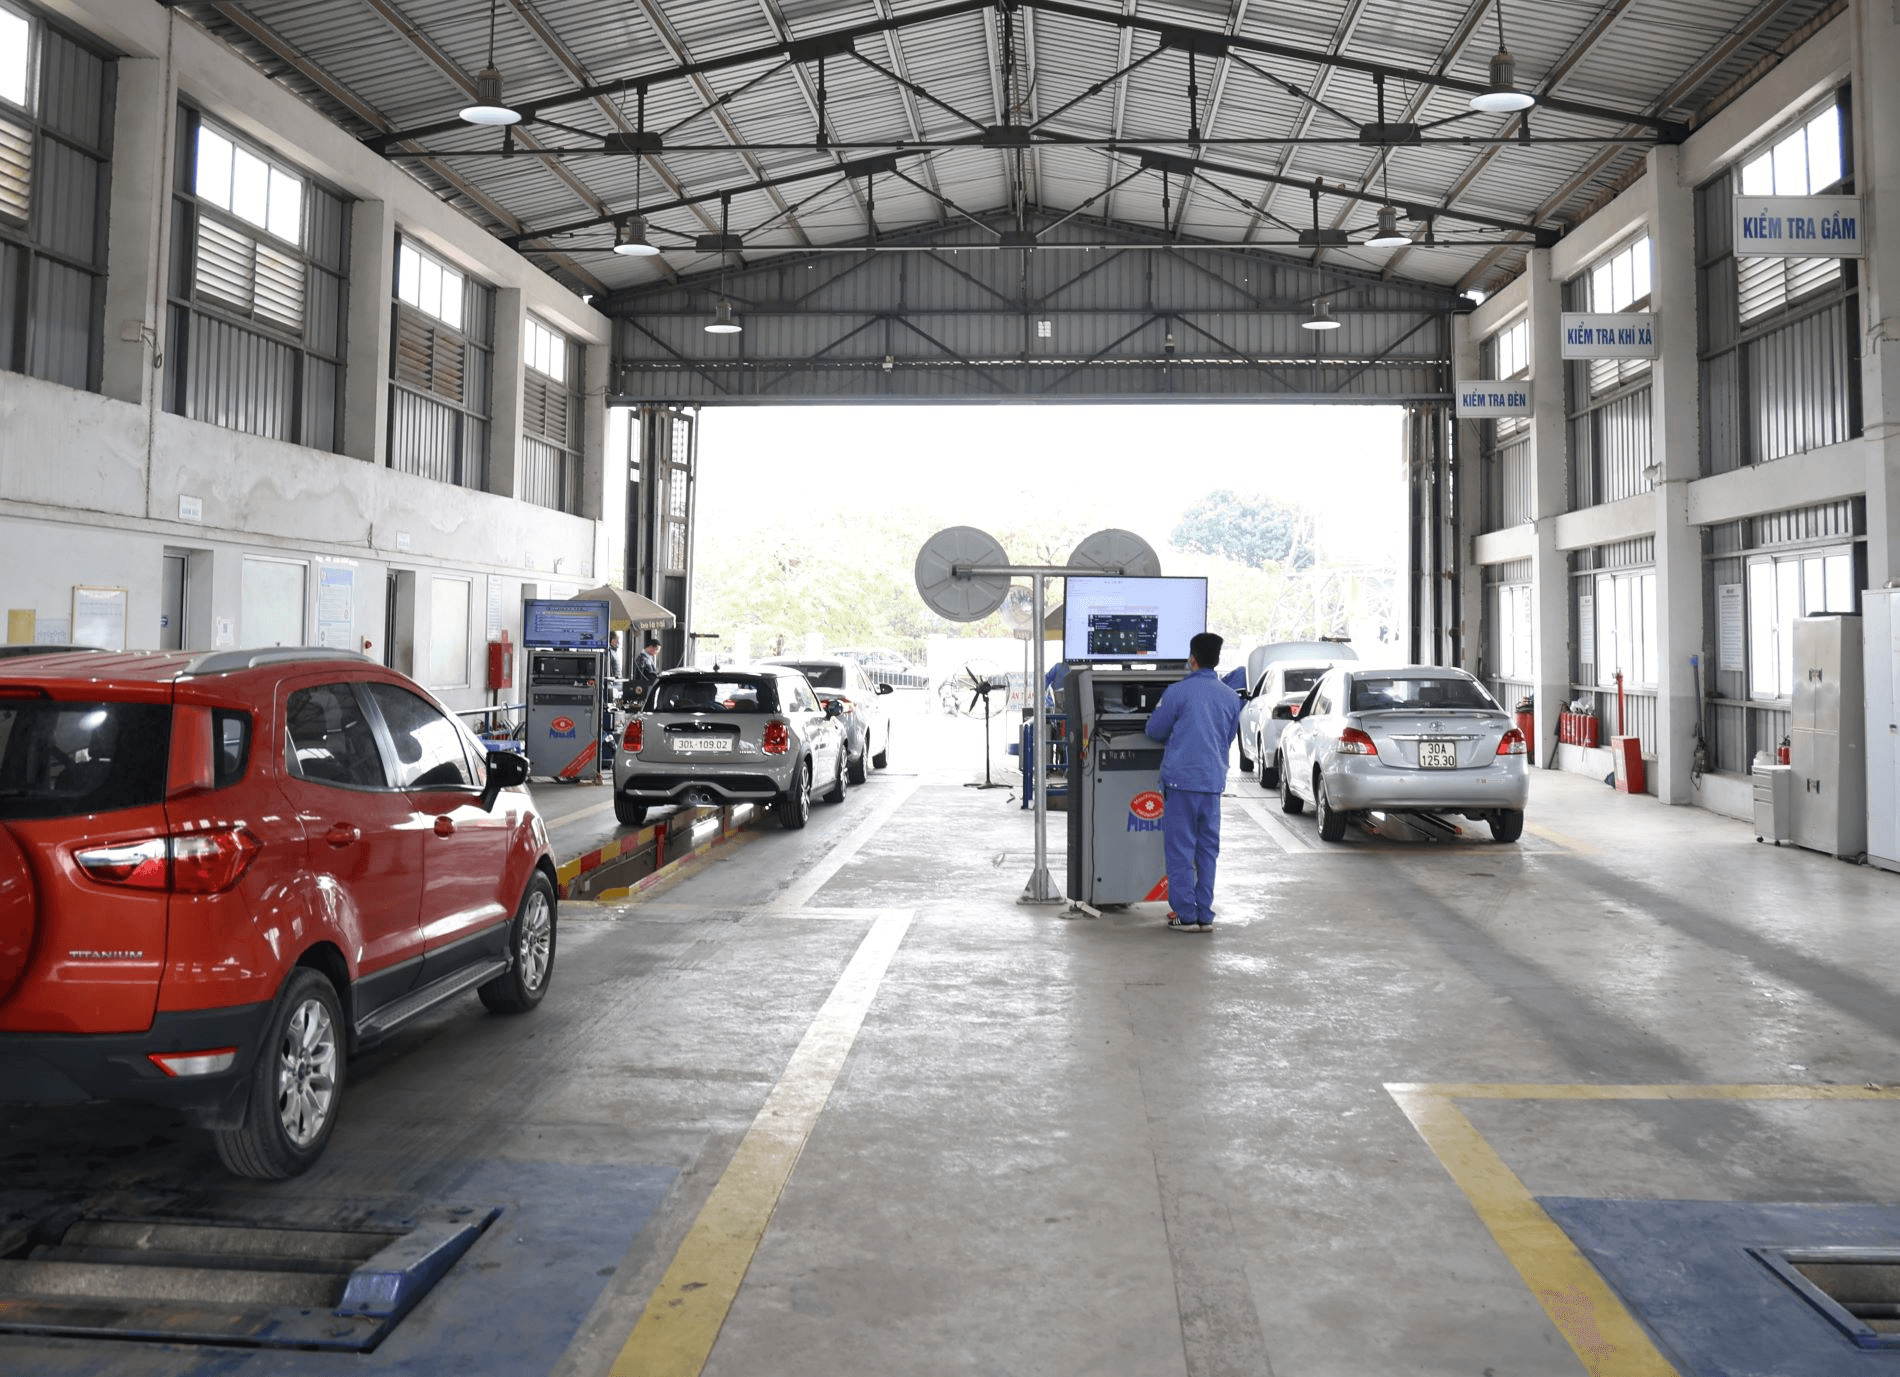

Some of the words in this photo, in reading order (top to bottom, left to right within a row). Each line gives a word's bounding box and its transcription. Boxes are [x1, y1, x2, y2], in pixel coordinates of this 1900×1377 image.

[1743, 207, 1782, 239] KIỂM
[1786, 217, 1816, 240] TRA
[1820, 209, 1856, 240] GẦM
[1567, 321, 1593, 345] KIỂM
[1595, 328, 1615, 345] TRA
[1618, 324, 1635, 345] KHÍ
[1638, 322, 1652, 345] XẢ
[1462, 388, 1486, 407] KIỂM
[1488, 393, 1505, 407] TRA
[1507, 390, 1526, 407] ĐÈN
[1427, 743, 1447, 754] 30A
[1422, 755, 1455, 766] 125.30
[1127, 810, 1164, 832] MAH
[69, 950, 143, 959] TITANIUM
